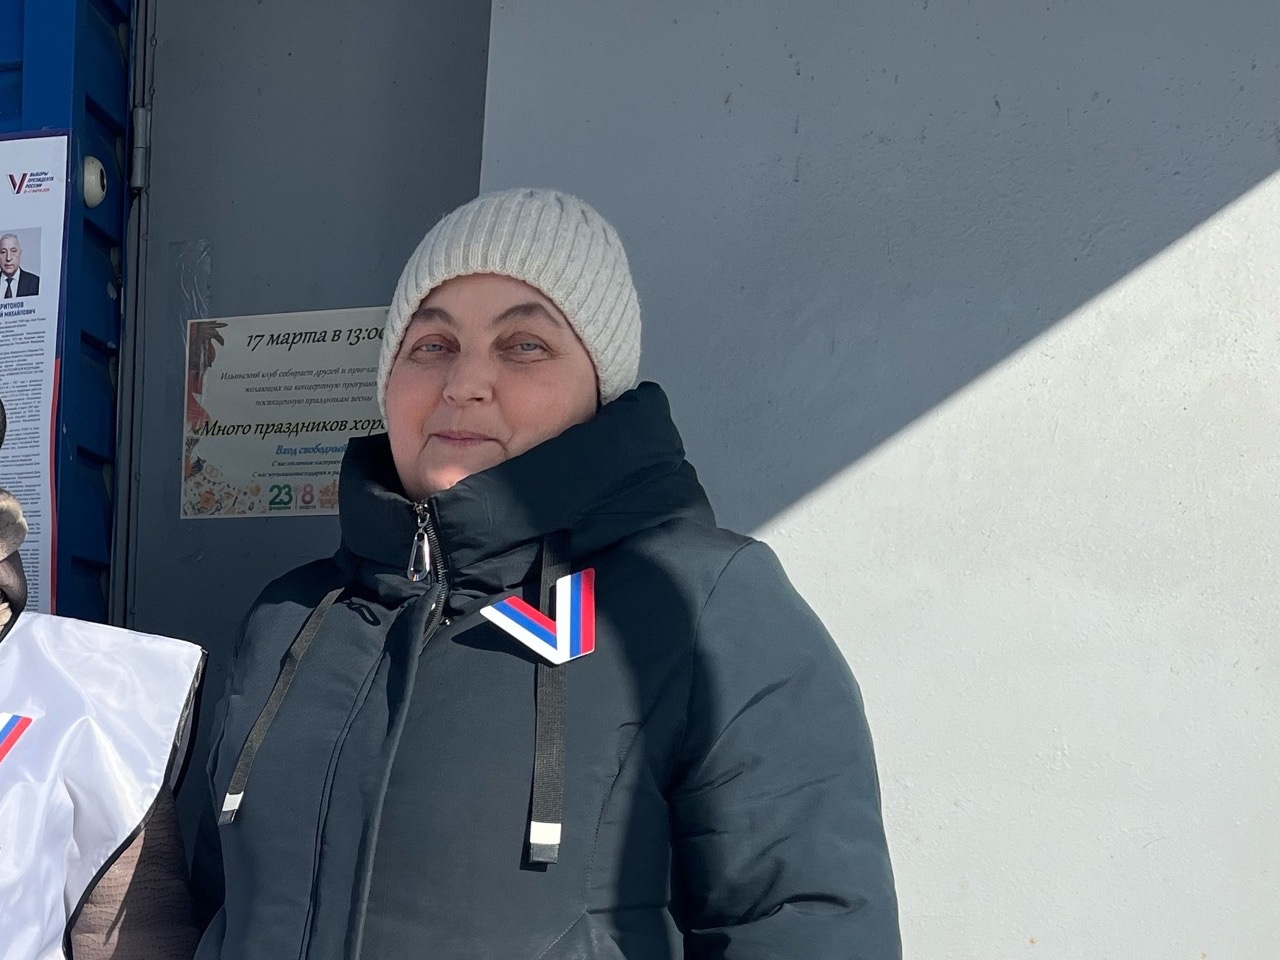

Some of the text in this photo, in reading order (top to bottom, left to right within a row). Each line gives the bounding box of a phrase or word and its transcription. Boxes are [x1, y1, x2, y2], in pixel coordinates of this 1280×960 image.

[4, 308, 36, 317] МИХАЙЛОВИЧ
[246, 334, 265, 352] 17
[266, 329, 327, 352] марта
[330, 329, 342, 342] в
[261, 368, 279, 380] клуб
[254, 420, 347, 440] праздников
[276, 445, 298, 457] Вход
[269, 484, 314, 506] 23 8
